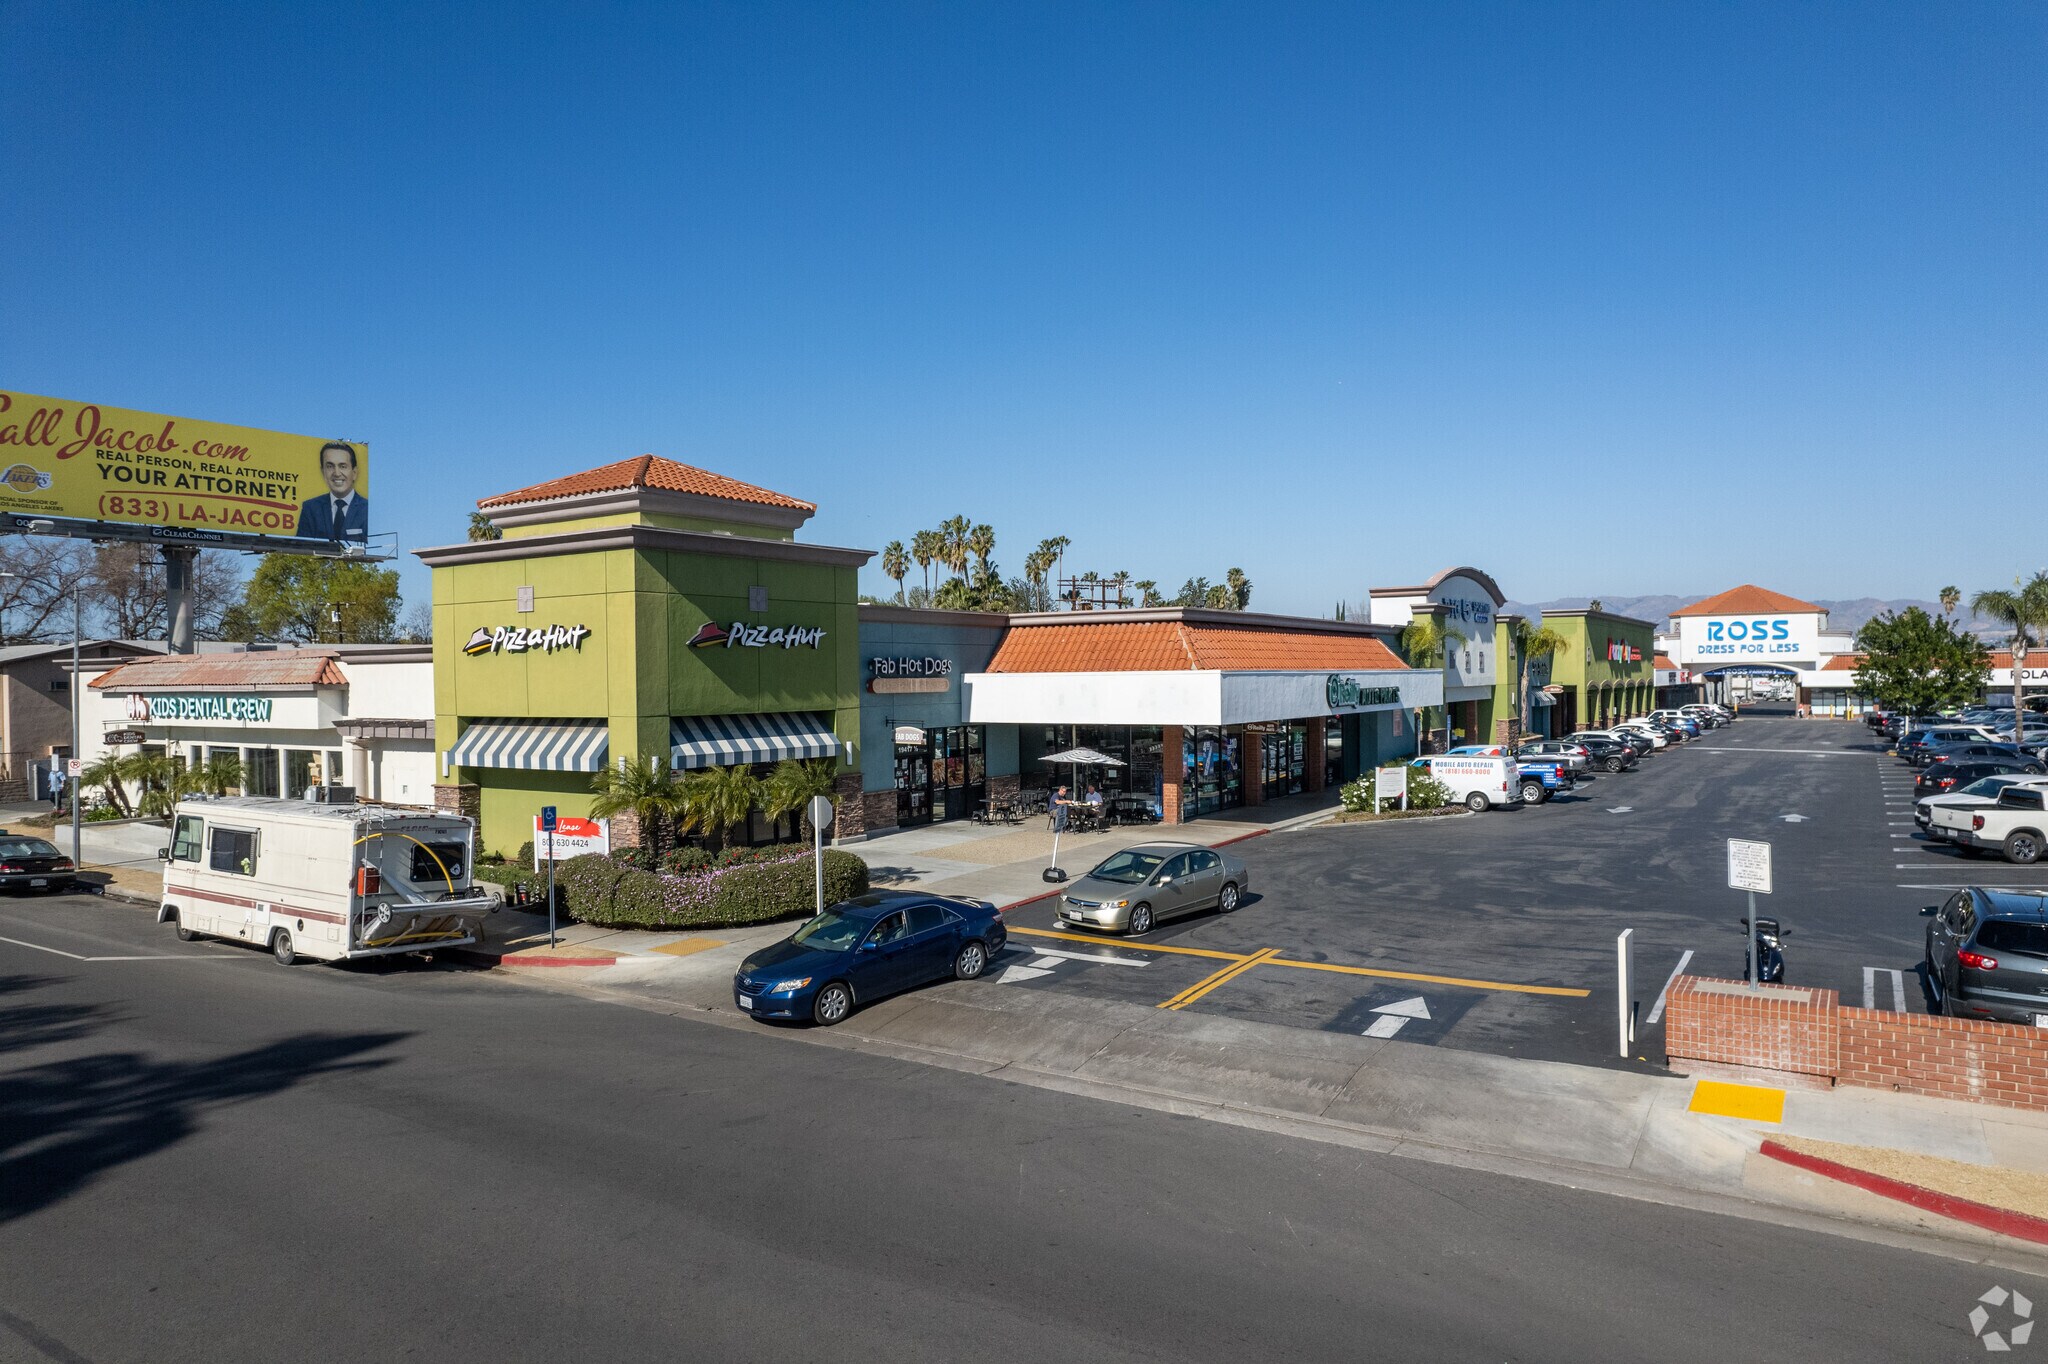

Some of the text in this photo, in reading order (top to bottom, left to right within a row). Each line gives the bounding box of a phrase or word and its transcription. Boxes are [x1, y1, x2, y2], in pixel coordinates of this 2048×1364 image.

[96, 449, 299, 483] REAL PERSON, REAL ATTORNEY
[96, 463, 297, 501] YOUR ATTORNEY!
[98, 495, 296, 530] (833) LA-JACOB
[1707, 620, 1789, 641] ROSS
[1698, 643, 1800, 654] DRESS FOR LESS
[873, 656, 953, 675] Fab Hot Dogs
[1360, 687, 1380, 705] AUTO
[1380, 686, 1400, 704] PARTS
[149, 696, 271, 721] KIDS DENTAL CREW
[905, 733, 920, 741] DOGS
[558, 820, 581, 833] Lease
[556, 839, 570, 847] 630
[571, 839, 589, 847] 4424
